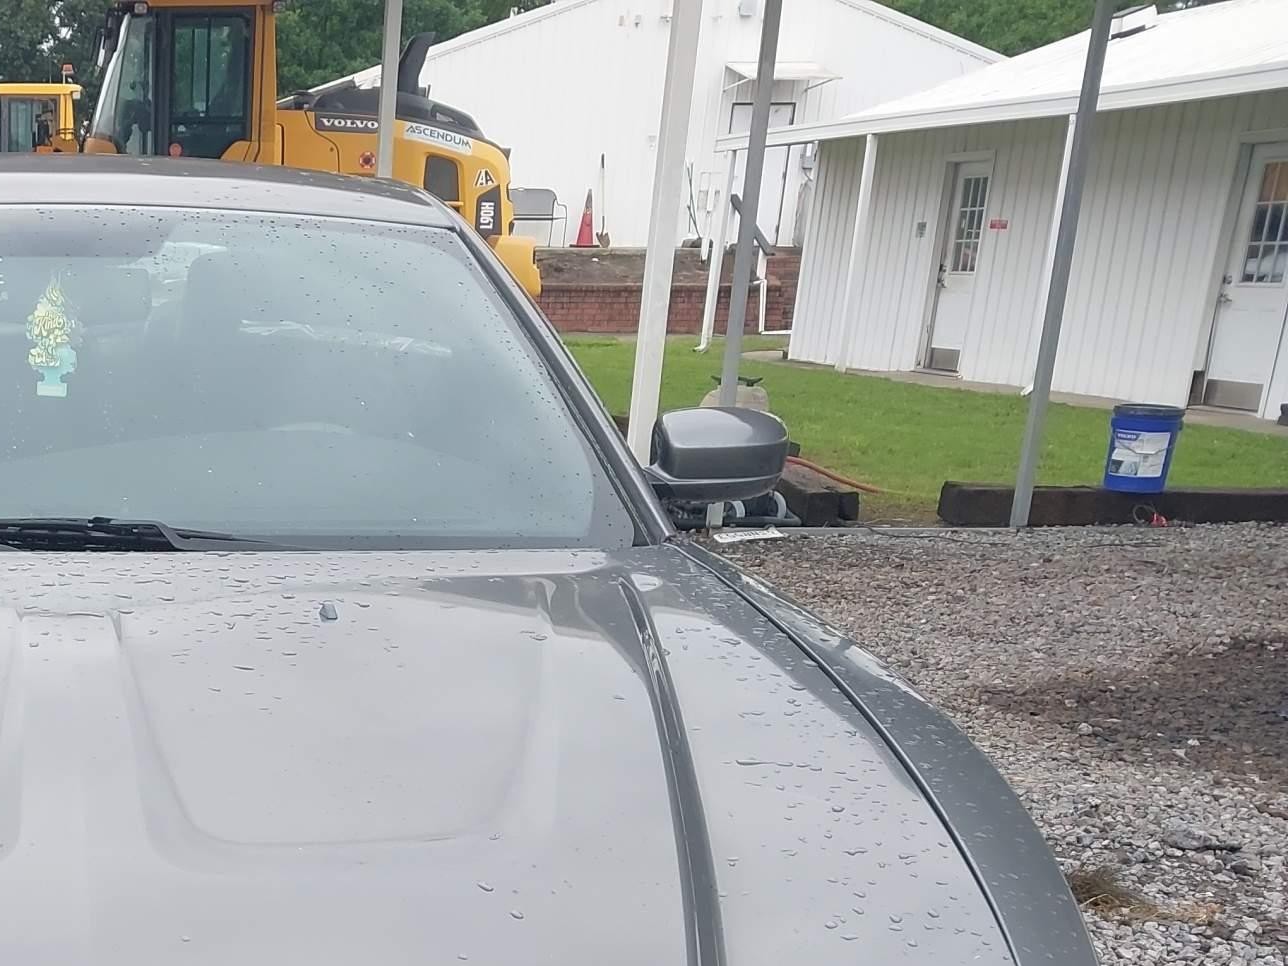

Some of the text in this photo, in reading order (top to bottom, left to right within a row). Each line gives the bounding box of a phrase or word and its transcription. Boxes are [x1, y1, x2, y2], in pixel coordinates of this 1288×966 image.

[319, 117, 379, 129] VOLVO
[406, 125, 472, 150] ASCENDUM
[479, 202, 495, 230] L90H
